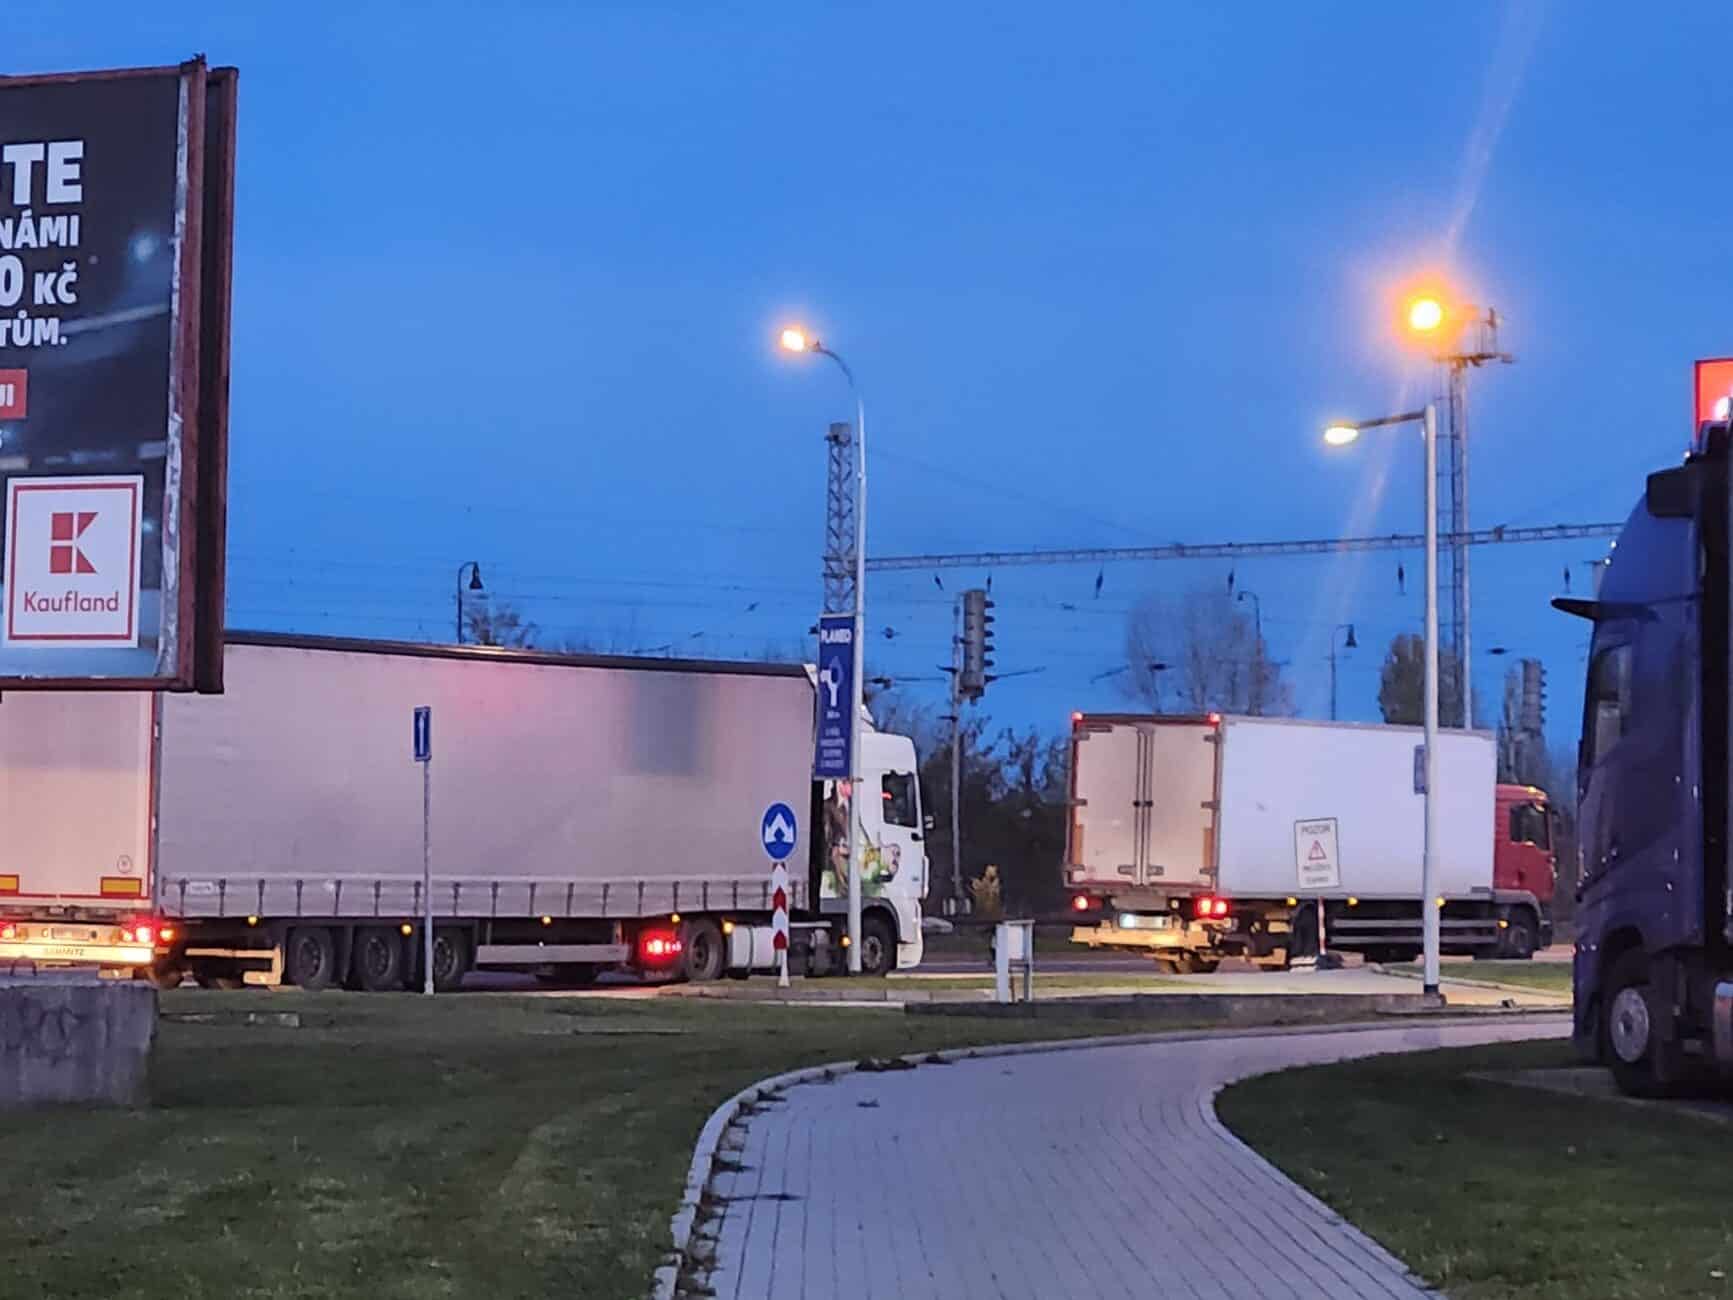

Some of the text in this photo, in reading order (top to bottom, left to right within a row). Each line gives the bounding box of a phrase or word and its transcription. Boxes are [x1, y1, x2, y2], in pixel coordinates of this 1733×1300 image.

[3, 140, 84, 205] TE
[0, 209, 80, 249] NÁMI
[34, 261, 78, 305] KČ
[0, 310, 67, 347] TŮM.
[24, 590, 119, 613] Kaufland
